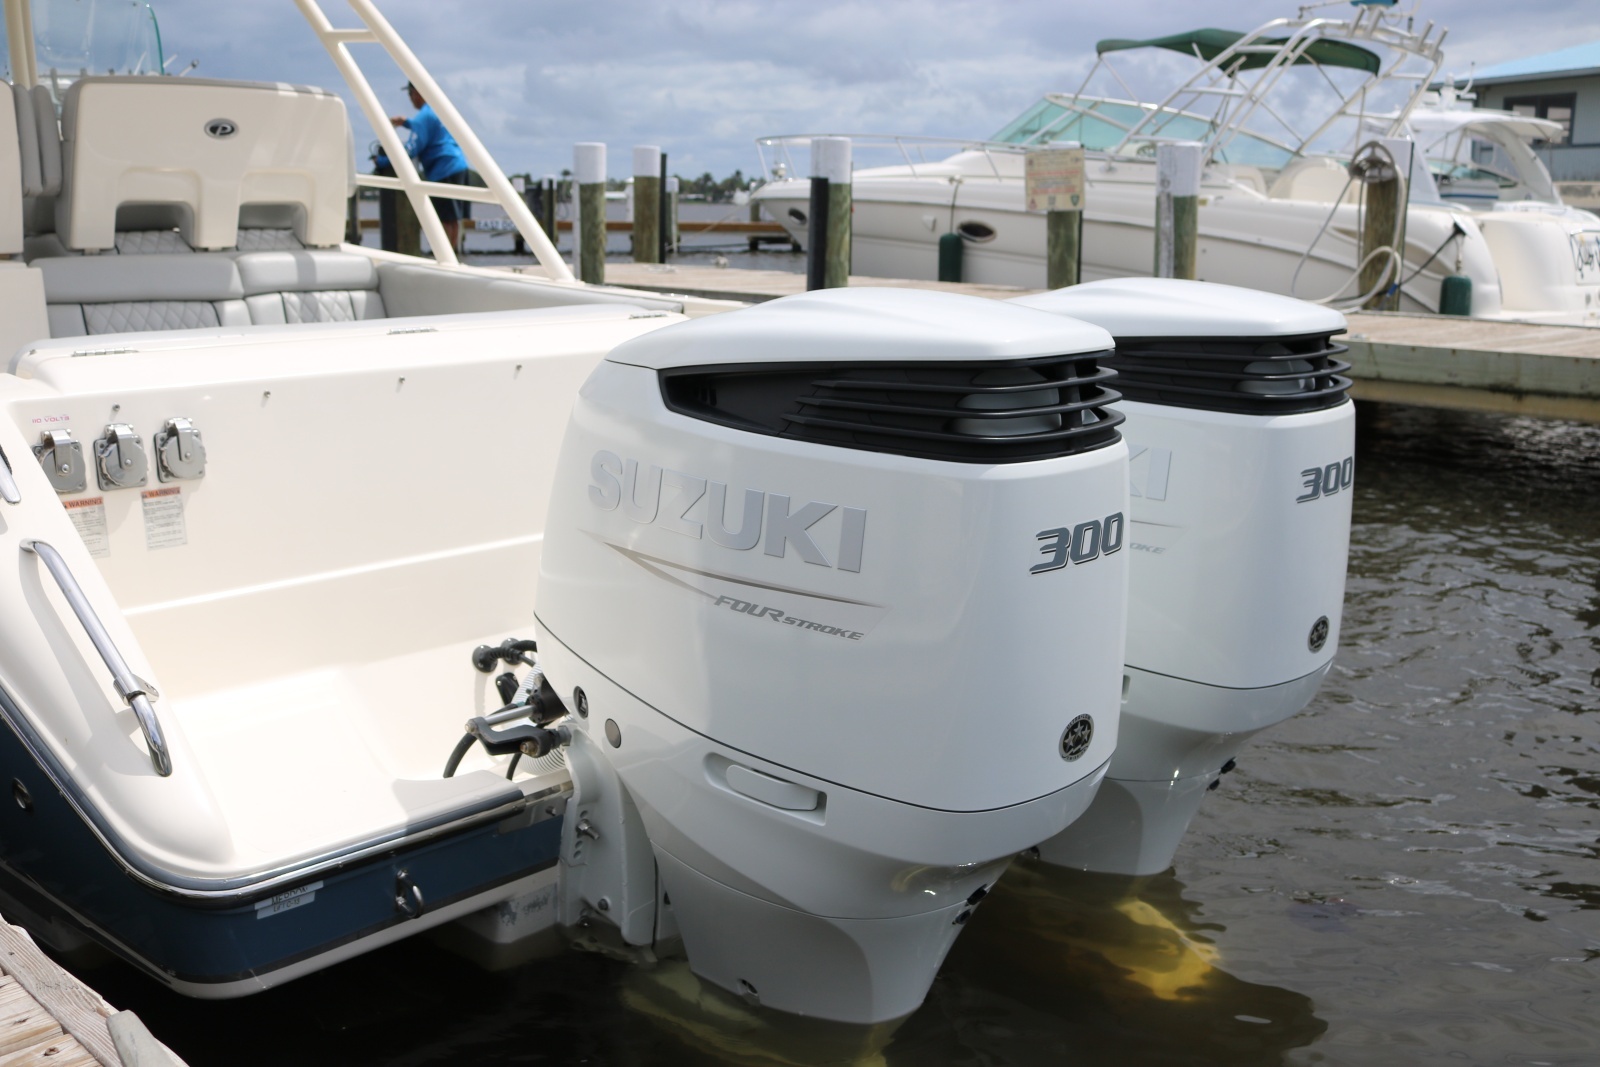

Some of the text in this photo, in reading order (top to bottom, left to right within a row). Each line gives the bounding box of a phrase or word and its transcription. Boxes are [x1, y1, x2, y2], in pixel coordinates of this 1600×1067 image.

[69, 498, 102, 508] WARNING
[1296, 457, 1352, 504] 300
[588, 450, 867, 573] SUZUKI
[1029, 512, 1124, 575] 300
[714, 595, 864, 640] FOUR STROKE
